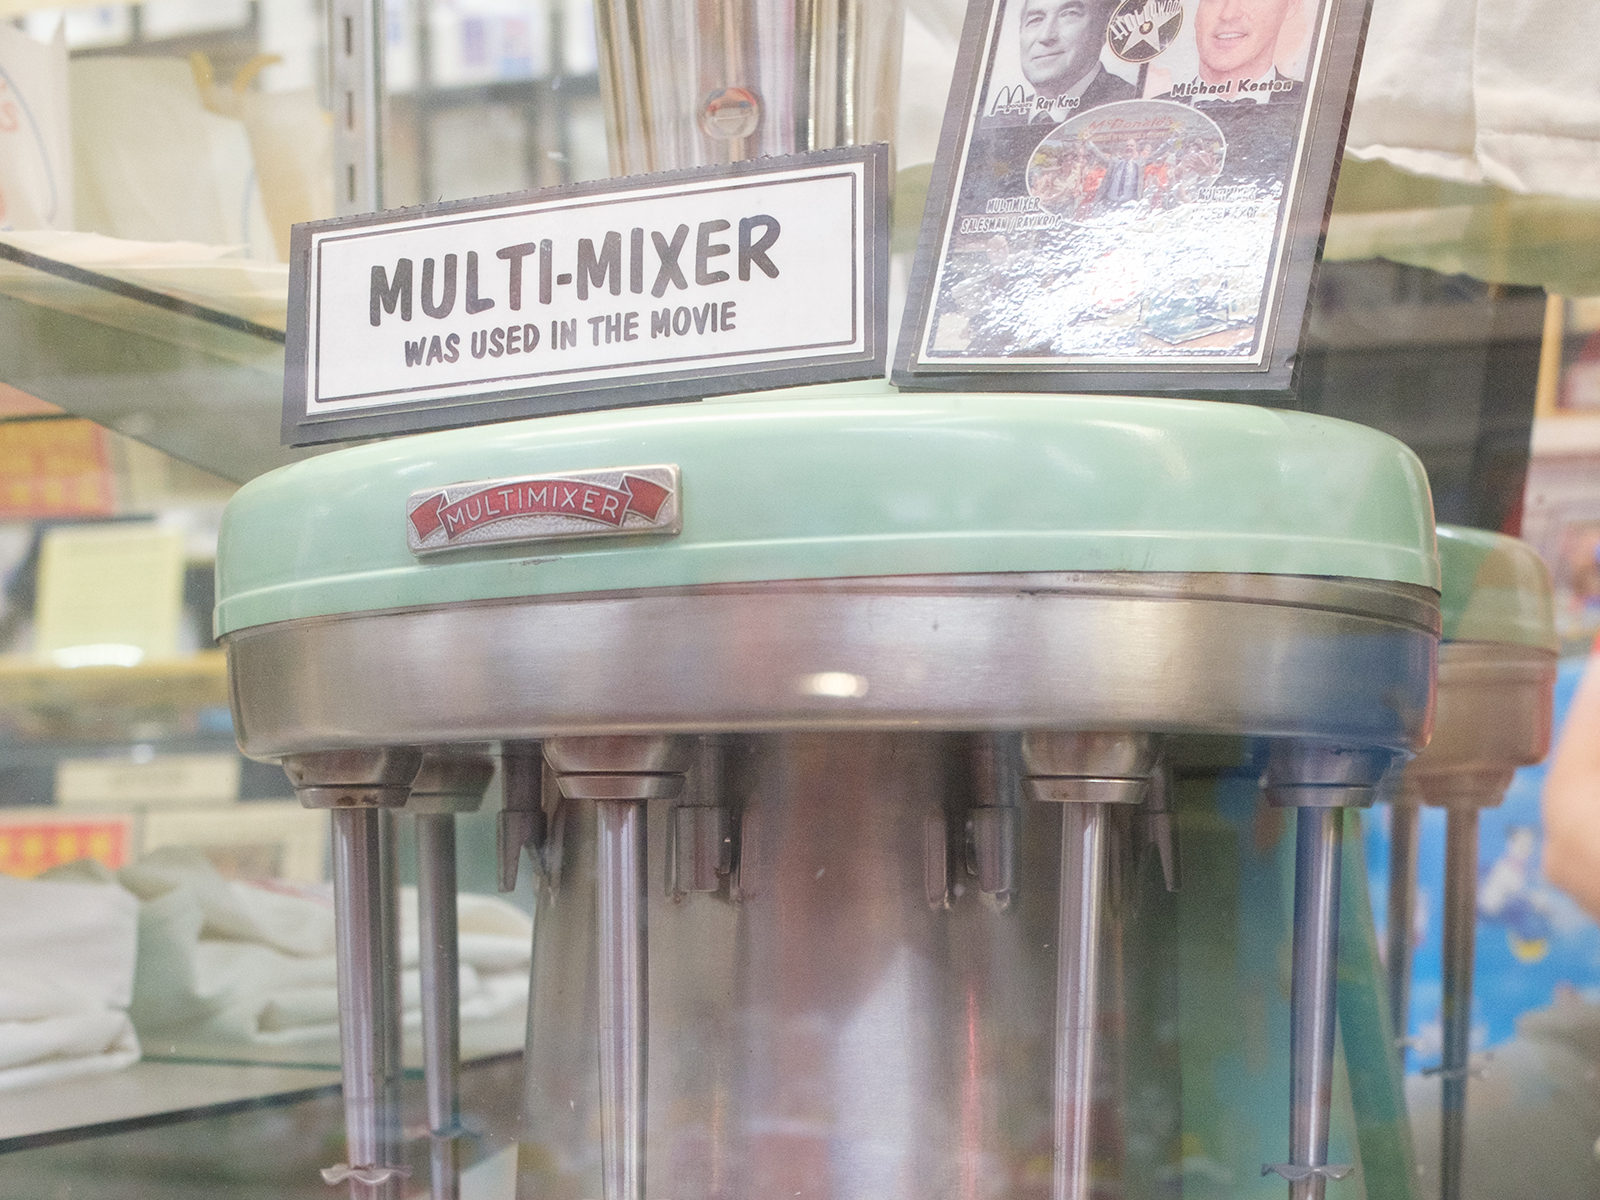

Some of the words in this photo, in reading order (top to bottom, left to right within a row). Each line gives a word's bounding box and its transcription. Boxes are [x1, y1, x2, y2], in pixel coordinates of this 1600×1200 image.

[1171, 80, 1232, 97] Michael
[1238, 78, 1293, 93] Keaton
[1036, 97, 1055, 112] Ray
[1057, 95, 1080, 109] Kroc
[1088, 116, 1175, 130] McDonald's
[985, 197, 1041, 213] MULTIMIXER
[369, 214, 782, 327] MULTI-MIXER
[404, 332, 461, 368] WAS
[471, 323, 541, 359] USED
[551, 318, 578, 351] IN
[588, 311, 640, 346] THE
[651, 301, 737, 339] MOVIE
[445, 486, 620, 532] MULTIMIXER
